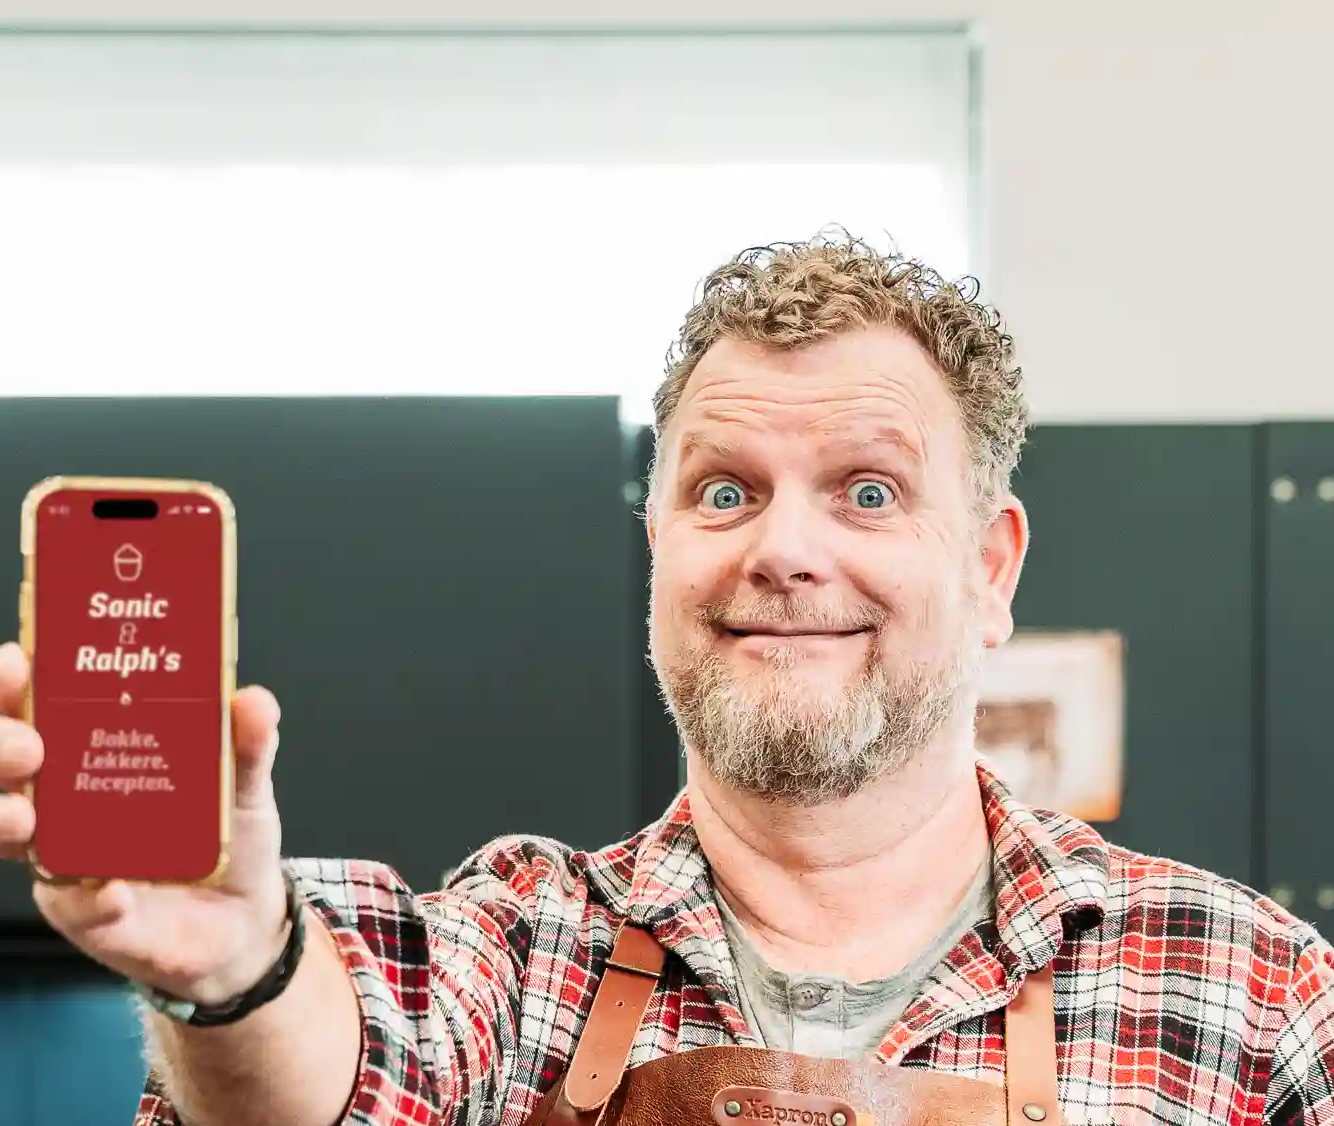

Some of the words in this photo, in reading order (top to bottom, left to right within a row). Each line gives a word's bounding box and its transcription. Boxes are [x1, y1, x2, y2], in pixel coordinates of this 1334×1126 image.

[88, 592, 168, 619] Sonic
[119, 622, 137, 645] &
[76, 645, 182, 678] Ralph's
[90, 729, 160, 748] Bokke.
[82, 751, 169, 770] Lekkere.
[75, 772, 176, 795] Recepten.
